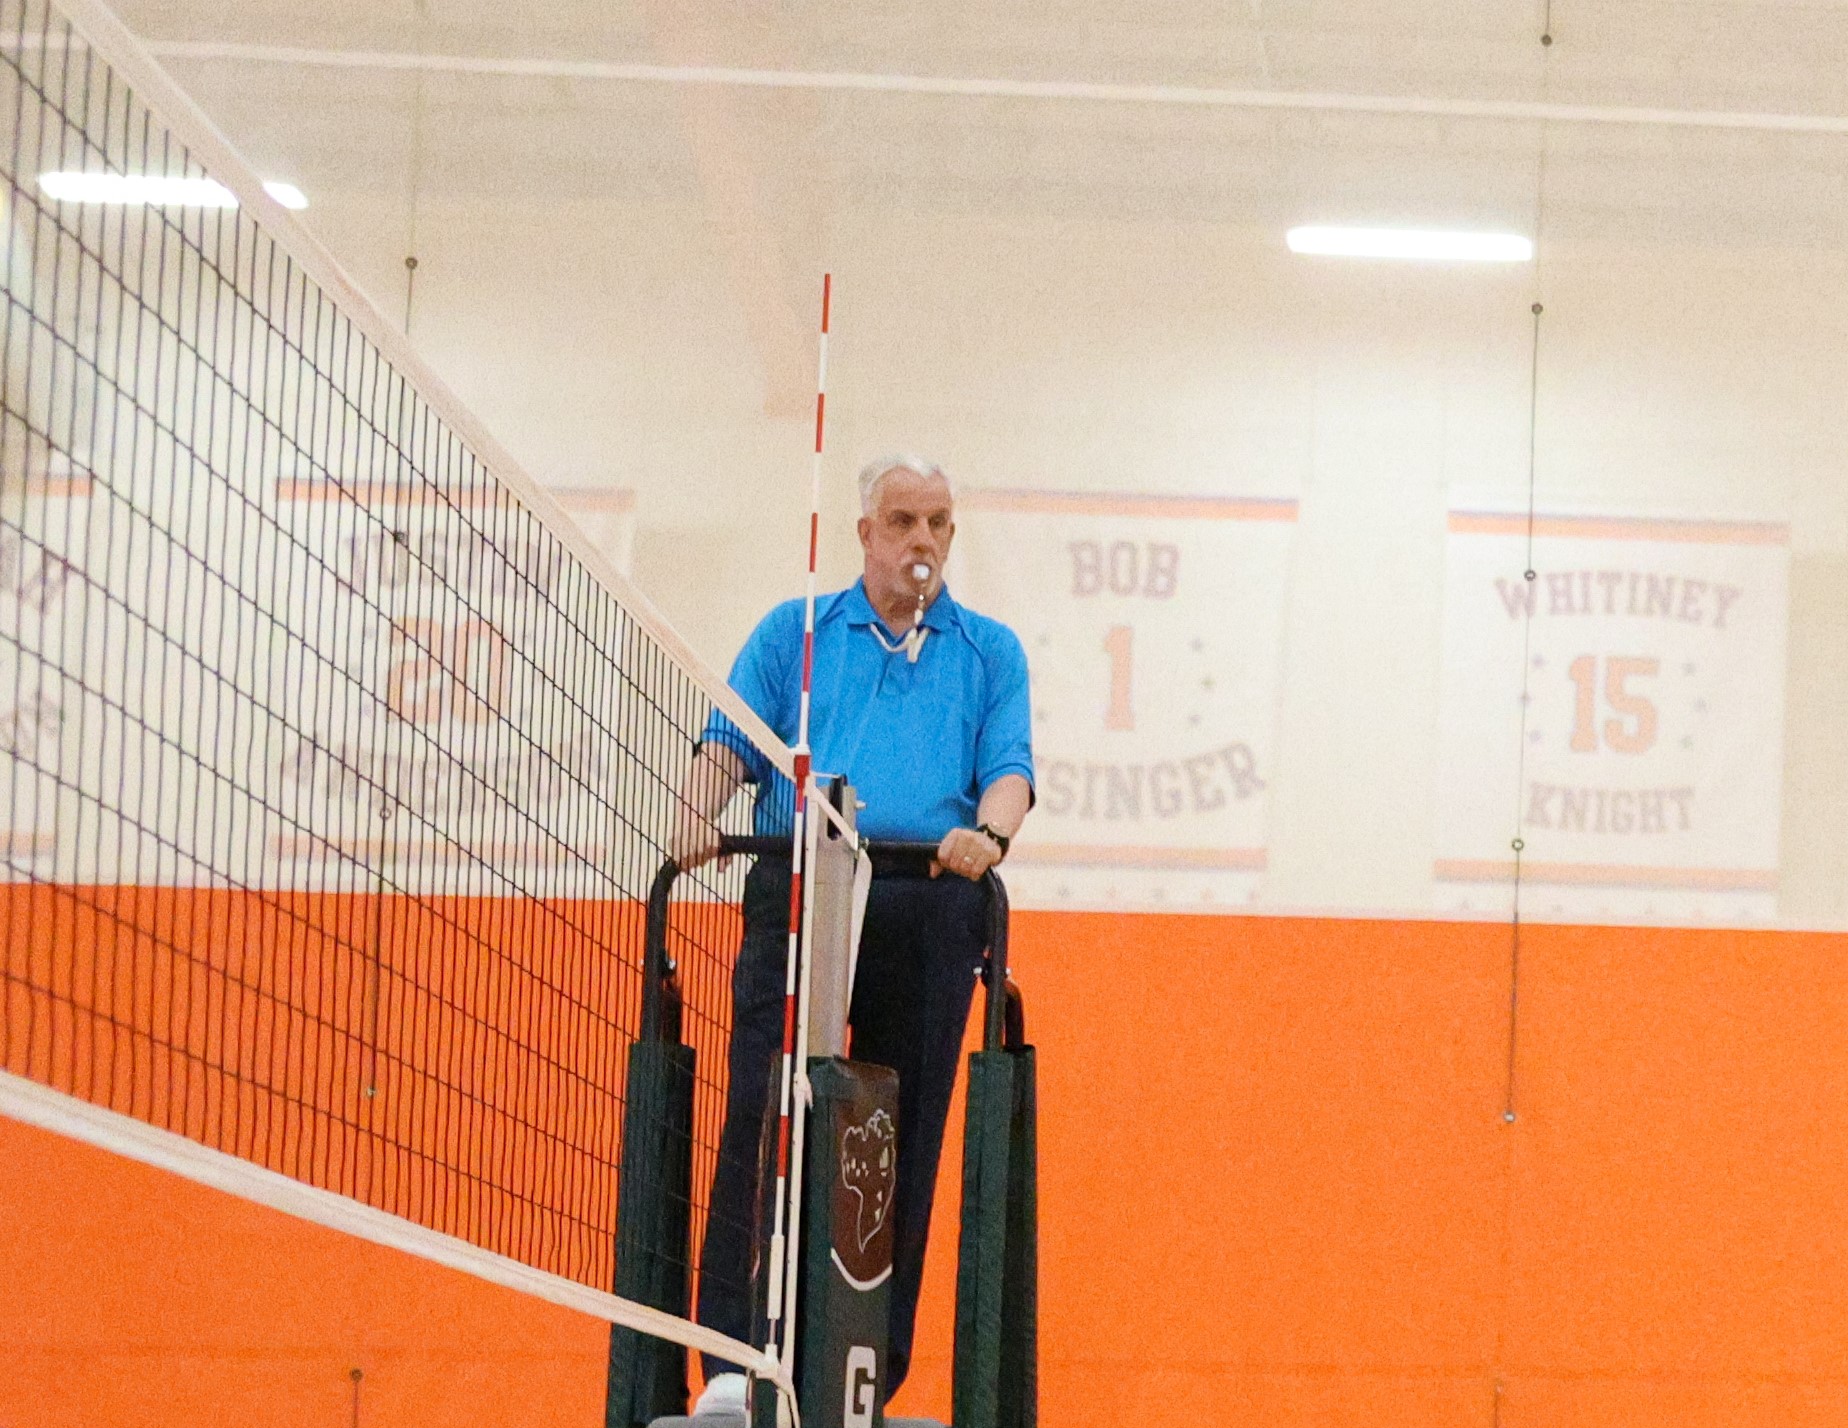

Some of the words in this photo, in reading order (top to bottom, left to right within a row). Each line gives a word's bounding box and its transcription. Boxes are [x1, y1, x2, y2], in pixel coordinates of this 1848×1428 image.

[1070, 539, 1181, 600] BOB
[1494, 570, 1743, 629] WHITINEY
[385, 616, 516, 726] 20
[1103, 626, 1135, 731] 1
[1567, 653, 1661, 755] 15
[1034, 741, 1267, 821] SINGER
[1524, 781, 1696, 834] KNIGHT
